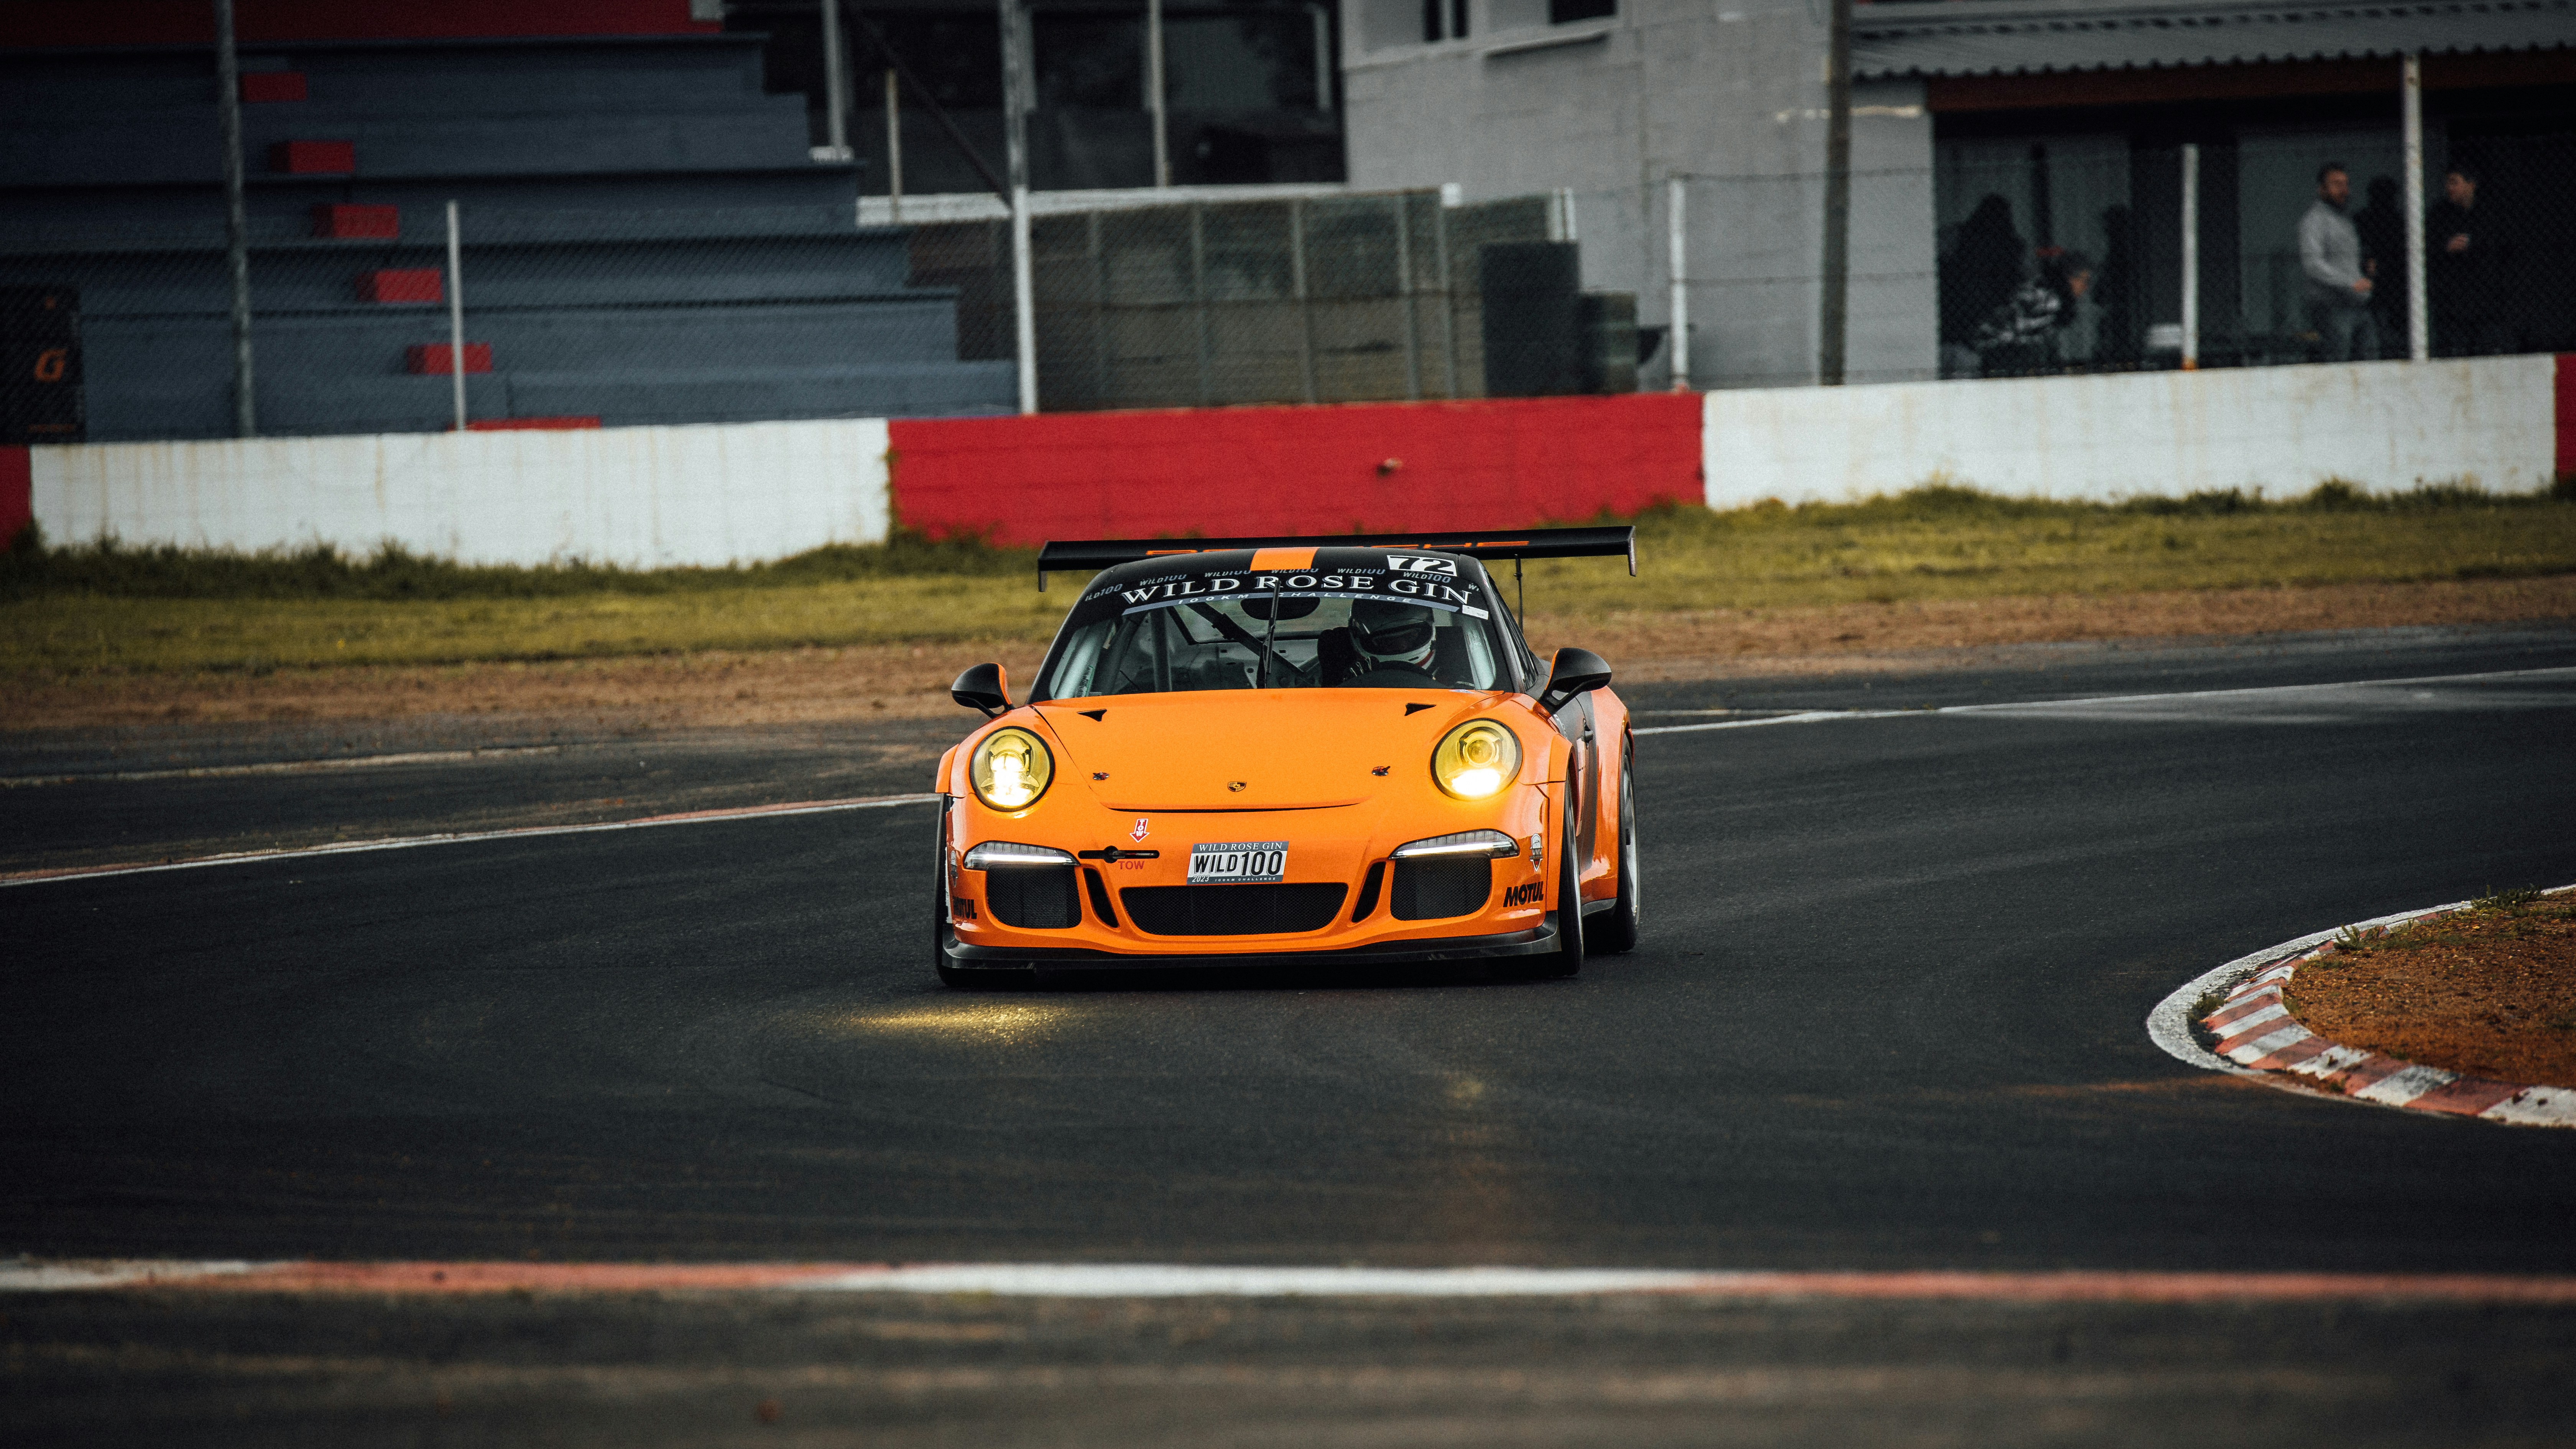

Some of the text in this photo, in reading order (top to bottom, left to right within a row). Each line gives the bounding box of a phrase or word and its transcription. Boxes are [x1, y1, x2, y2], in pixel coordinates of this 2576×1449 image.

[1390, 556, 1454, 575] 72
[1085, 584, 1123, 601] ILD100
[1403, 572, 1452, 583] WILD100
[1120, 575, 1473, 605] WILD ROSE GIN
[1178, 594, 1249, 605] 100KM
[1136, 820, 1145, 837] TOW
[1199, 844, 1227, 852] WILD
[1118, 860, 1145, 870] TOW
[1194, 850, 1283, 877] WILD100
[1503, 881, 1544, 907] MOTUL
